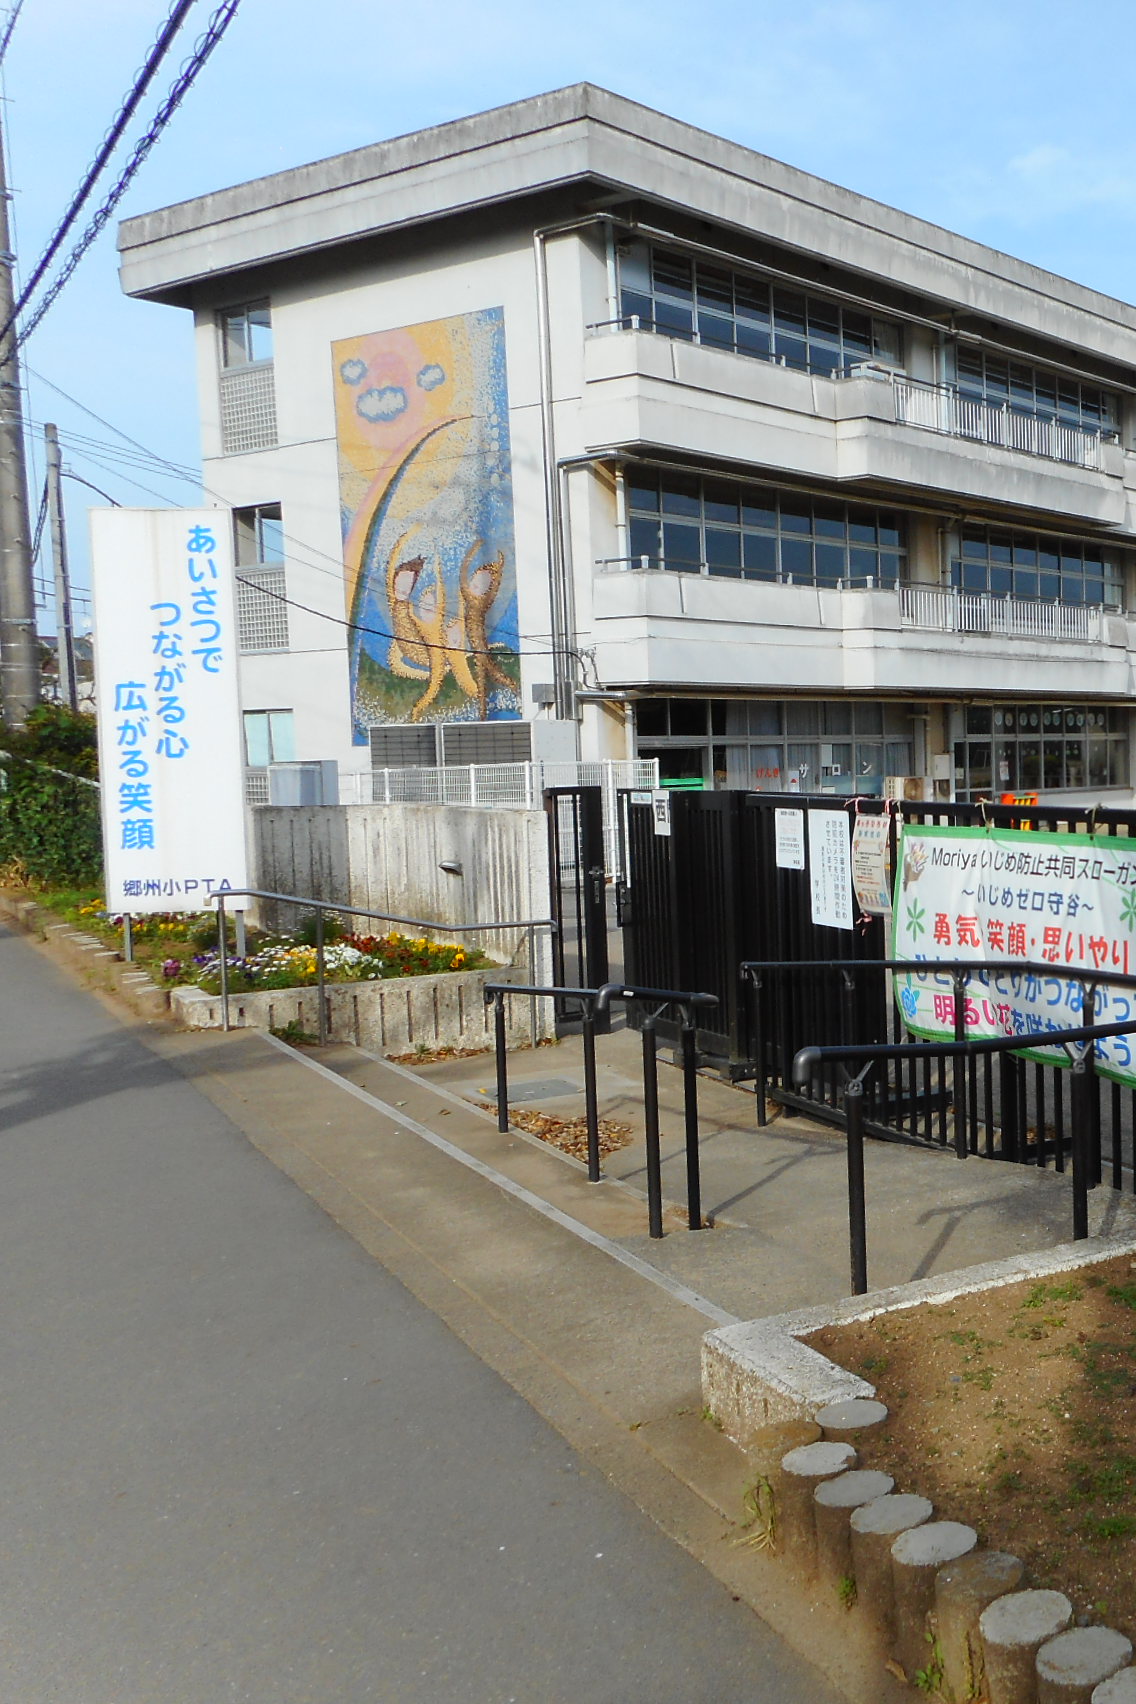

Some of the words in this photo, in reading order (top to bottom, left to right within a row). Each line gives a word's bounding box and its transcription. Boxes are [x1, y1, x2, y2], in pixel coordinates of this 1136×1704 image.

[186, 524, 224, 674] あいさつで
[150, 602, 189, 759] つながる心
[114, 681, 155, 850] 広がる笑顔
